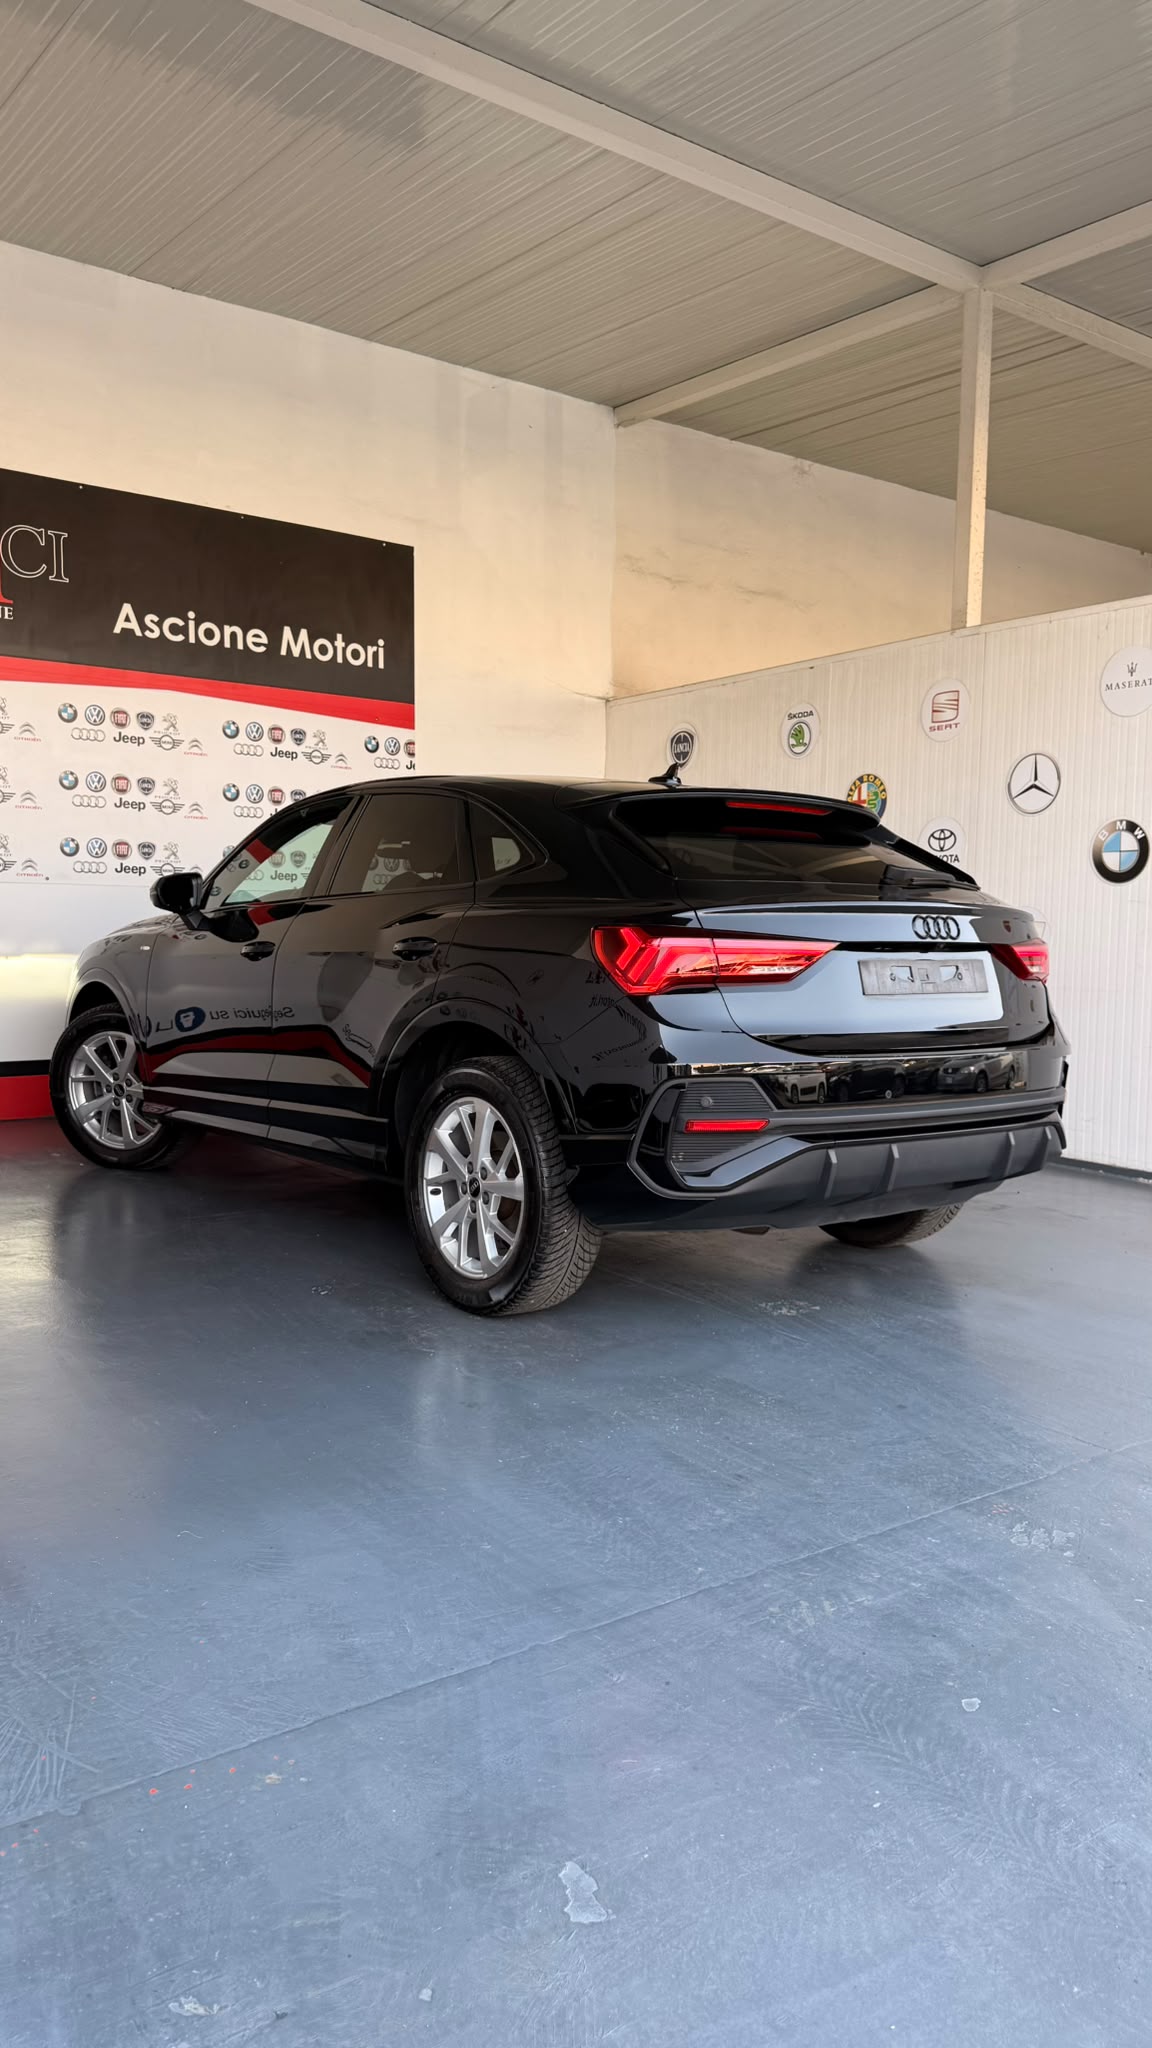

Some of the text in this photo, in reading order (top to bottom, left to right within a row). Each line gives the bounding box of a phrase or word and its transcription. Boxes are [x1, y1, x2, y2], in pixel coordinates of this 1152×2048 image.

[113, 603, 384, 669] Ascione Motori
[929, 722, 960, 732] SEAT
[113, 731, 145, 747] Jeep
[270, 747, 298, 761] Jeep
[114, 797, 146, 812] Jeep
[1098, 820, 1145, 841] BMW
[115, 862, 147, 876] Jeep
[270, 870, 298, 883] Jeep
